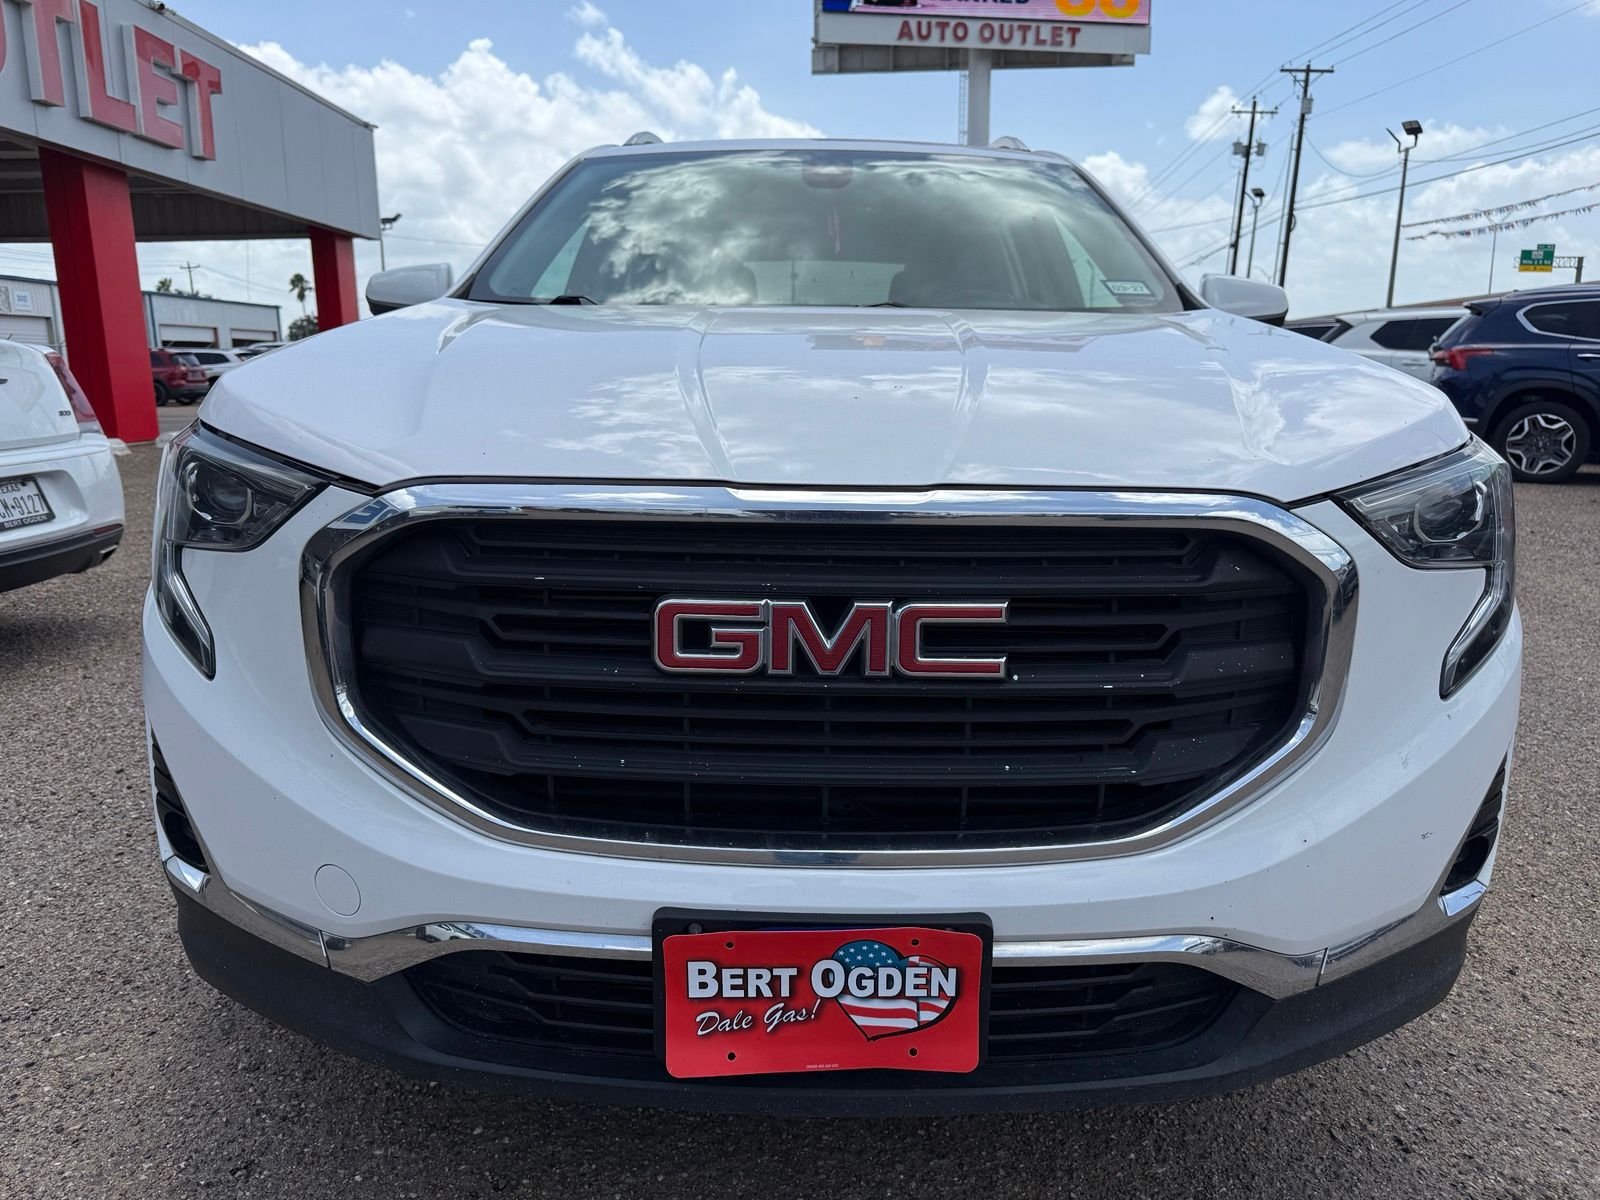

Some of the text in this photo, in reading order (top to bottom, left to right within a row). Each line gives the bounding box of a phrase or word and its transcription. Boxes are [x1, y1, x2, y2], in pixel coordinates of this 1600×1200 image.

[897, 20, 1081, 47] AUTO OUTLET
[0, 0, 222, 161] TLET
[0, 483, 21, 494] EXAS
[654, 599, 1008, 678] GMC
[686, 958, 958, 999] BERT OGDEN
[696, 999, 821, 1036] Dale Gas!
